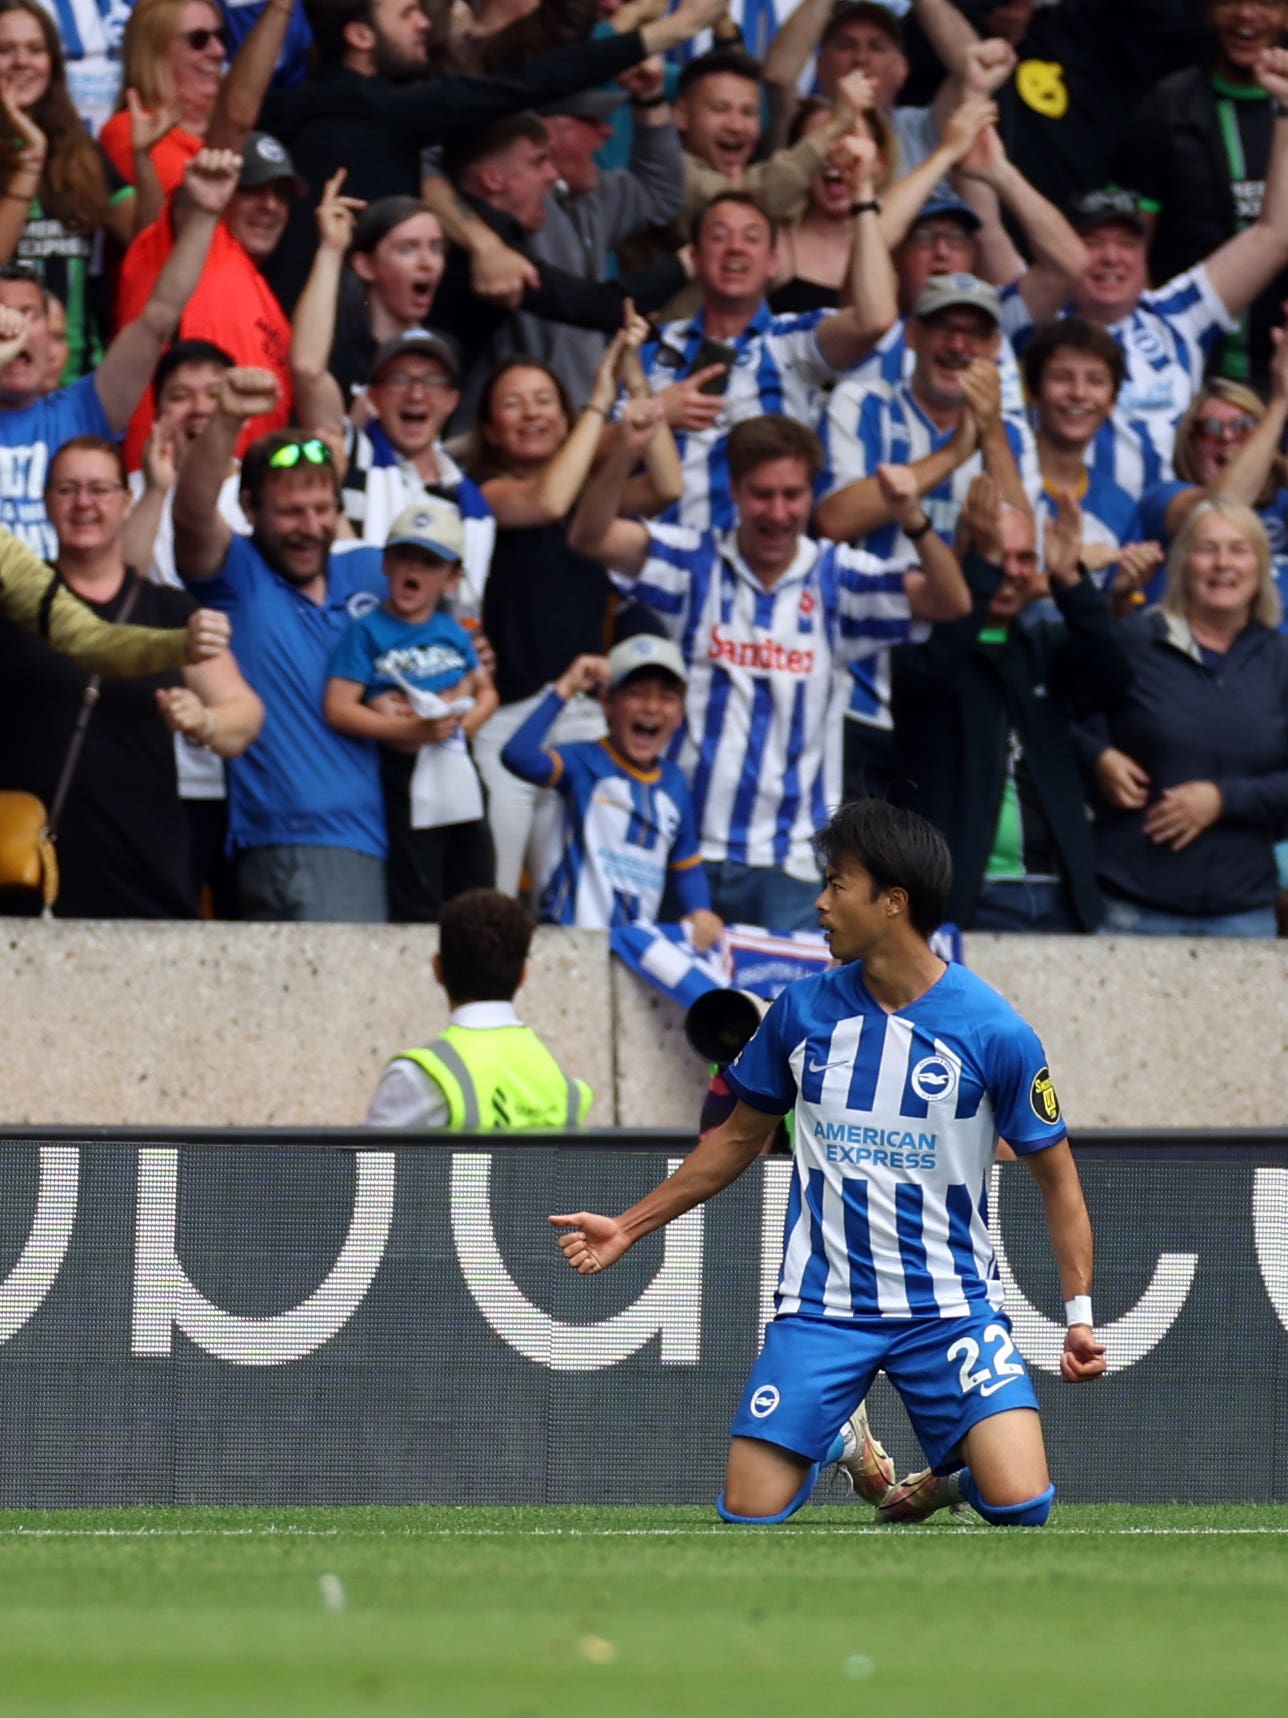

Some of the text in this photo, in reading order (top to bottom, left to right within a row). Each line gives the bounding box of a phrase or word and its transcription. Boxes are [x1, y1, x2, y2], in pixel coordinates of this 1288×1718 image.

[814, 1121, 936, 1151] AMERICAN
[826, 1144, 936, 1170] EXPRESS
[947, 1324, 1024, 1393] 22
